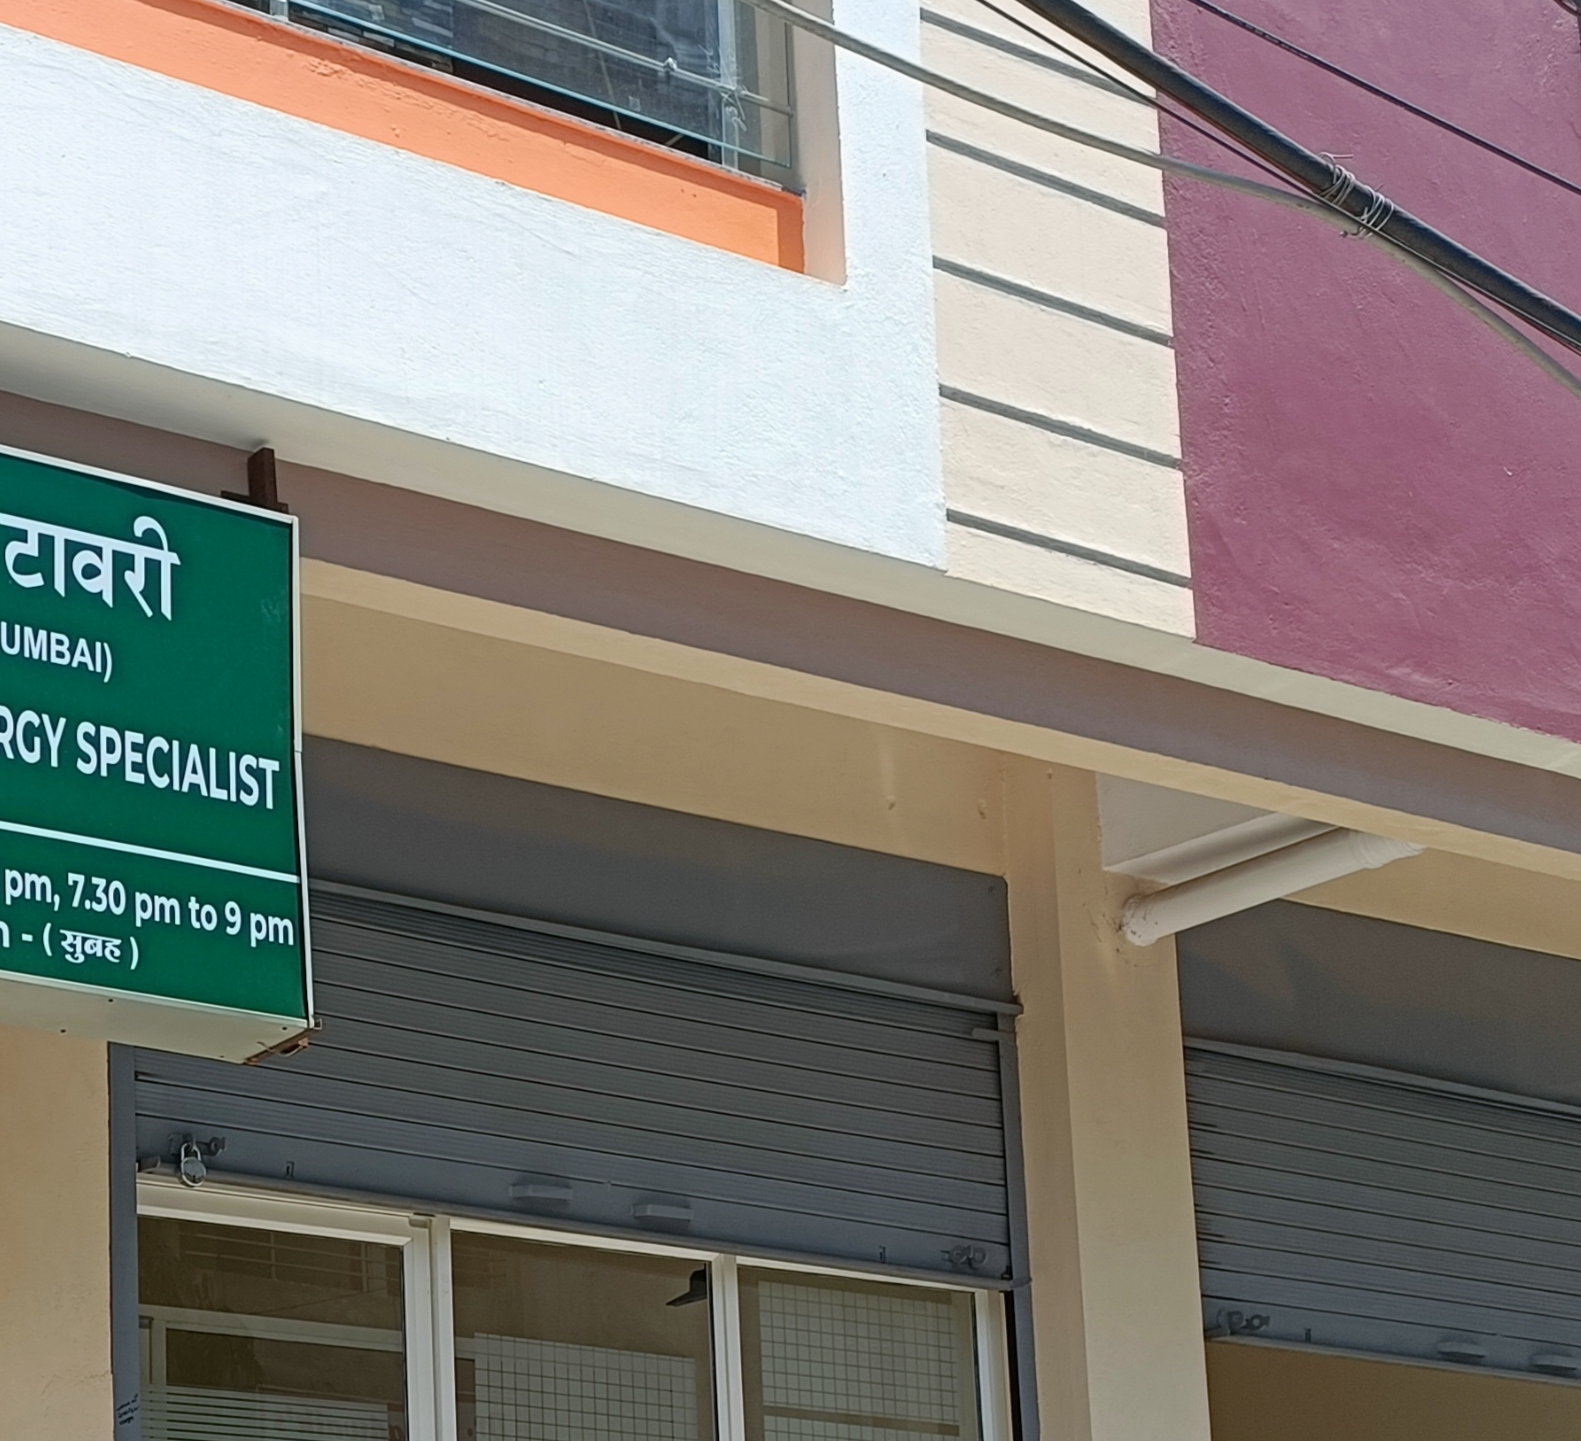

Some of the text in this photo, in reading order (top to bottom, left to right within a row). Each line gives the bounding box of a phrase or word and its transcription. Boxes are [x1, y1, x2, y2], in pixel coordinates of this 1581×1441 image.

[76, 721, 280, 810] SPECIALIST
[4, 869, 60, 911] pm,
[67, 872, 126, 915] 7.30
[135, 891, 181, 928] pm
[188, 896, 218, 931] to
[224, 901, 242, 935] 9
[250, 912, 294, 948] pm
